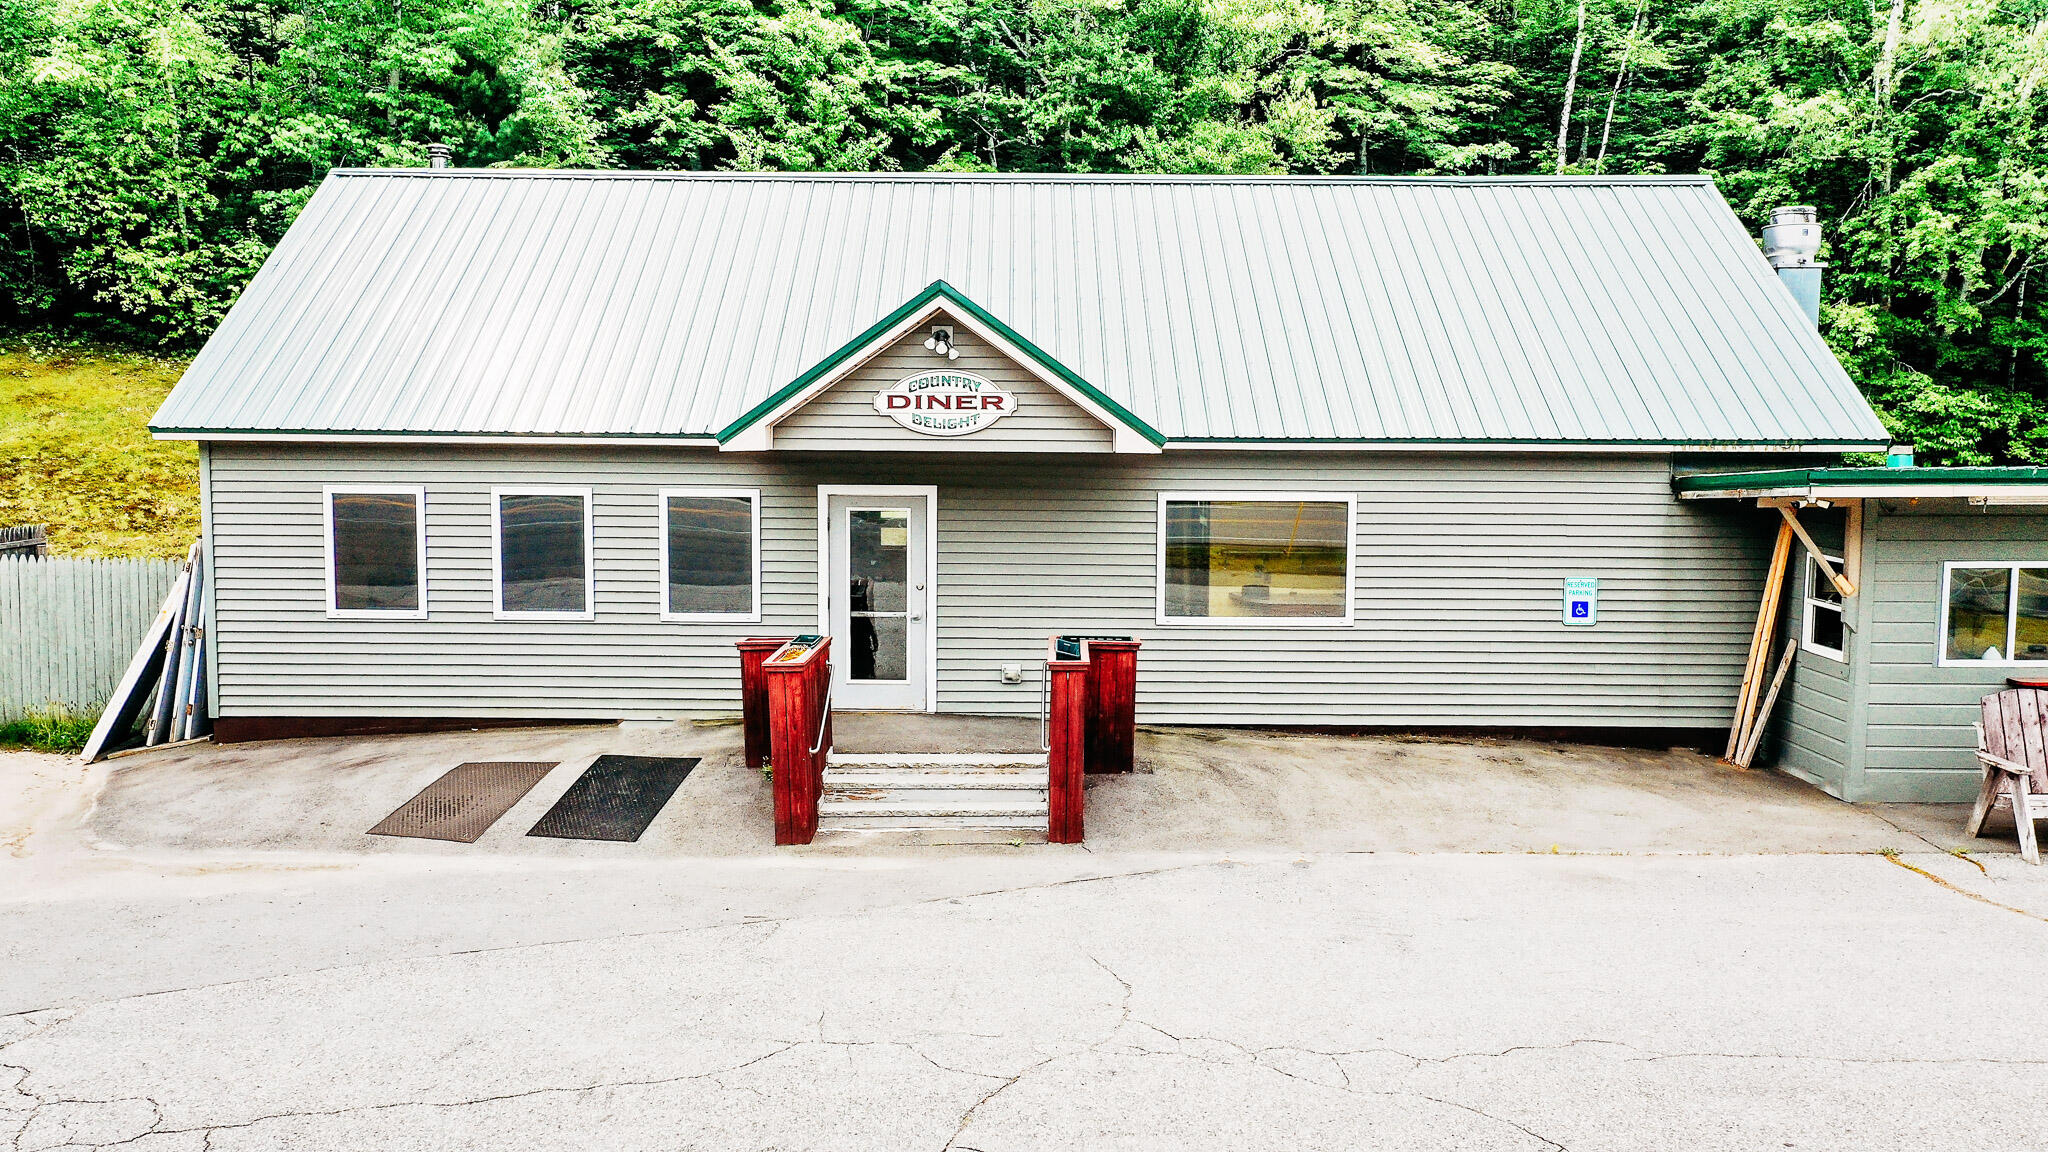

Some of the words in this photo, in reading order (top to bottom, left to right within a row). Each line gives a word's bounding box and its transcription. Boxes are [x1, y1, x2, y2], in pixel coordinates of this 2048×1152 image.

[908, 375, 982, 393] COUNTRY
[887, 394, 1005, 411] DINER
[911, 412, 981, 430] DELIGHT
[1567, 581, 1595, 589] RESERVED
